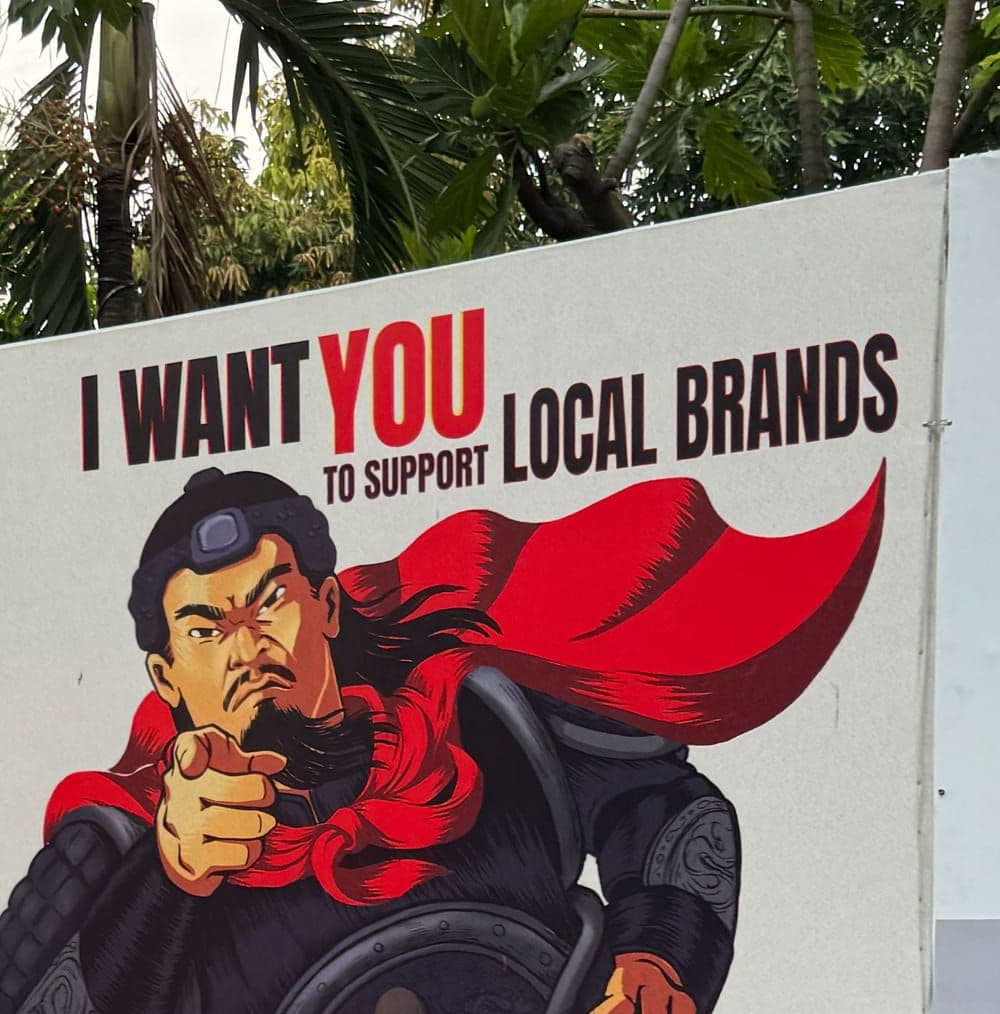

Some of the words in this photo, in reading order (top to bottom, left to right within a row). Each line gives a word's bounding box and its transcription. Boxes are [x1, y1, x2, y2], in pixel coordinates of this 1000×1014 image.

[81, 374, 100, 472] I
[118, 340, 310, 466] WANT
[318, 307, 485, 455] YOU
[503, 374, 658, 485] LOCAL
[676, 333, 899, 461] BRANDS
[323, 464, 356, 506] TO
[364, 444, 489, 499] SUPPORT
